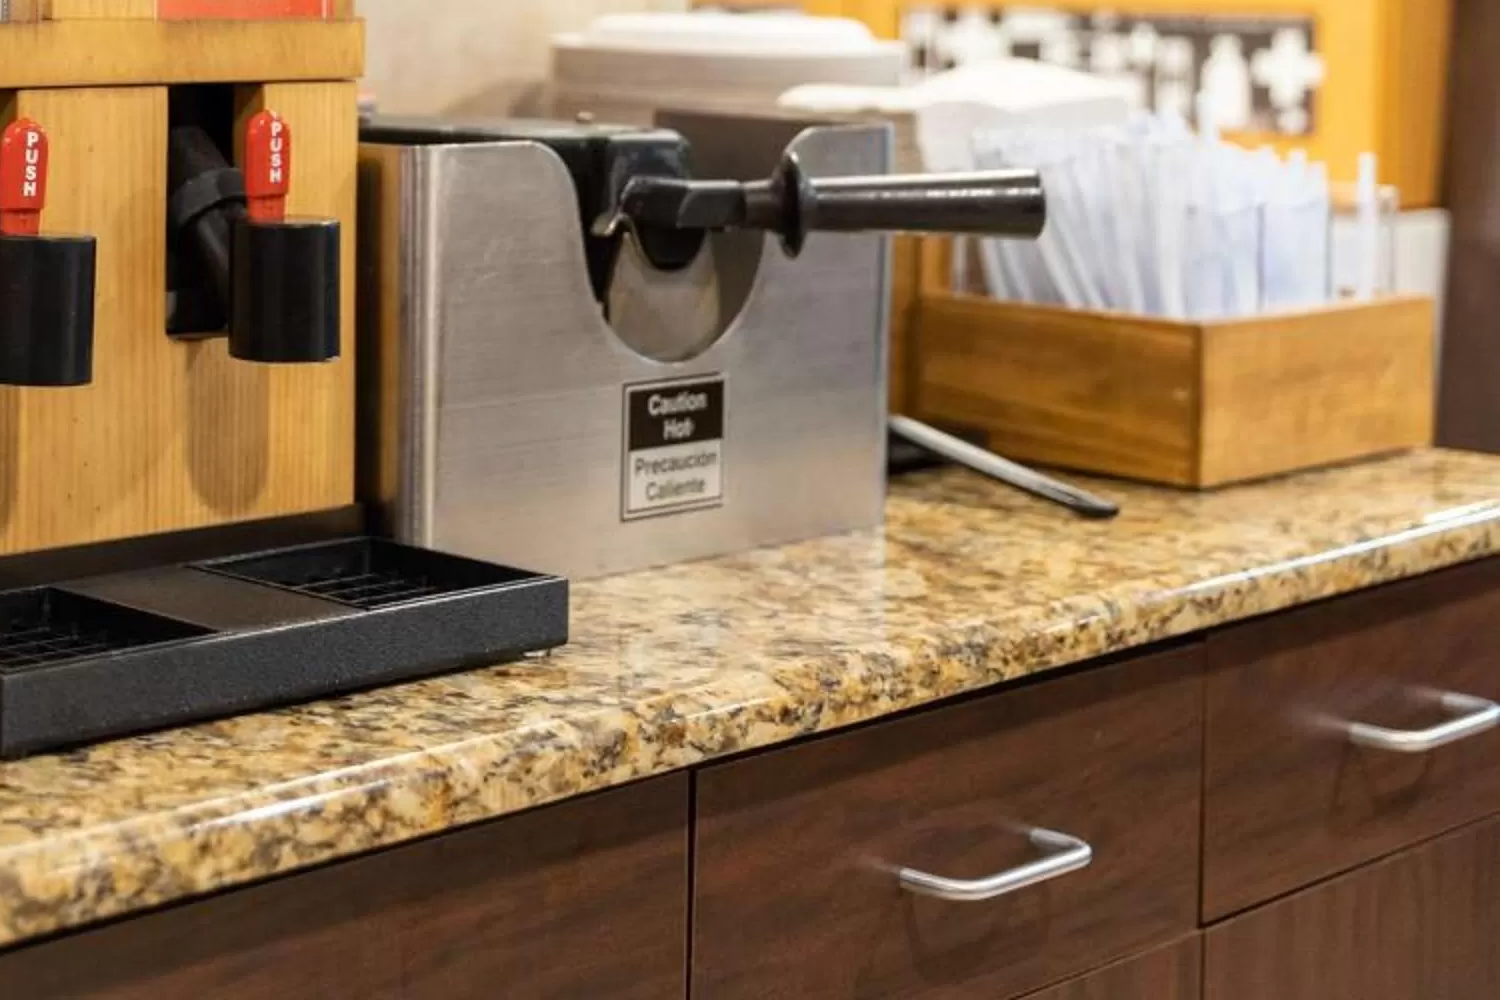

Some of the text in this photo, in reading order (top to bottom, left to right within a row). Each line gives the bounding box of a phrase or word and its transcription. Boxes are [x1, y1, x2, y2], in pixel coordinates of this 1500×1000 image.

[23, 131, 39, 196] PUSH
[269, 121, 282, 184] PUSH
[648, 391, 708, 416] Caution
[663, 417, 695, 440] Hot
[646, 476, 705, 501] Caliente
